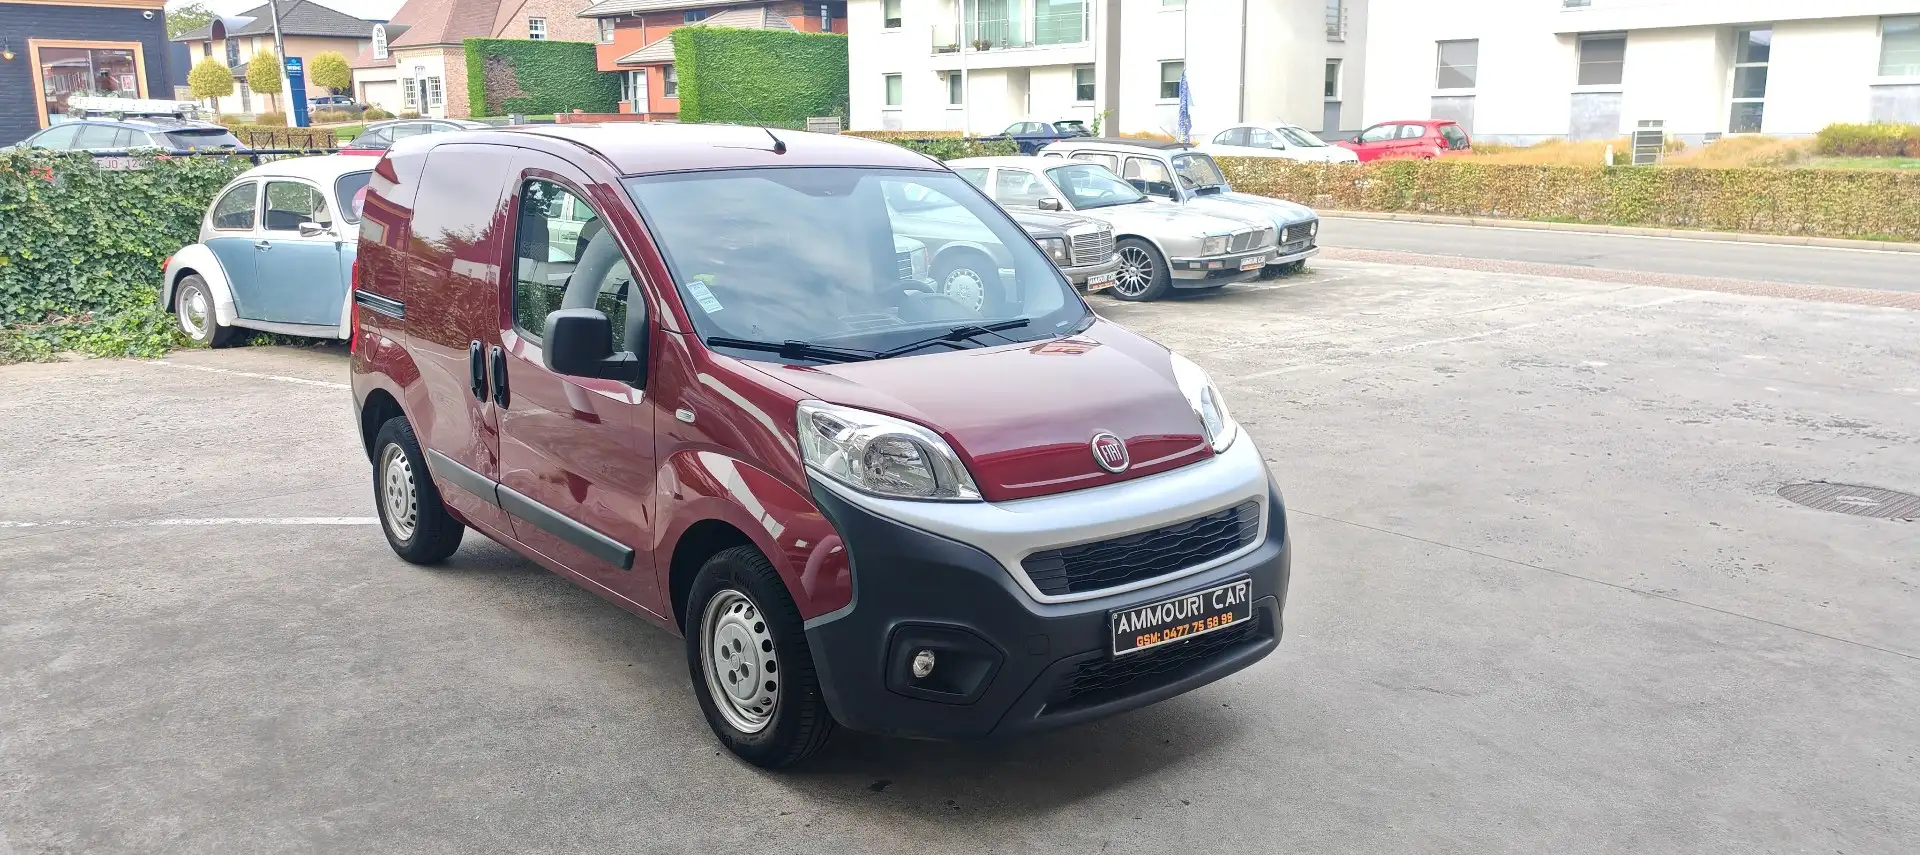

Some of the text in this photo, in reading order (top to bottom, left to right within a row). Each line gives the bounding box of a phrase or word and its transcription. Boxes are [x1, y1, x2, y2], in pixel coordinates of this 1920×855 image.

[1100, 443, 1122, 462] FIAT
[1117, 583, 1246, 634] AMMOURI CAR
[1136, 631, 1161, 647] GSM:
[1163, 623, 1190, 641] 0477
